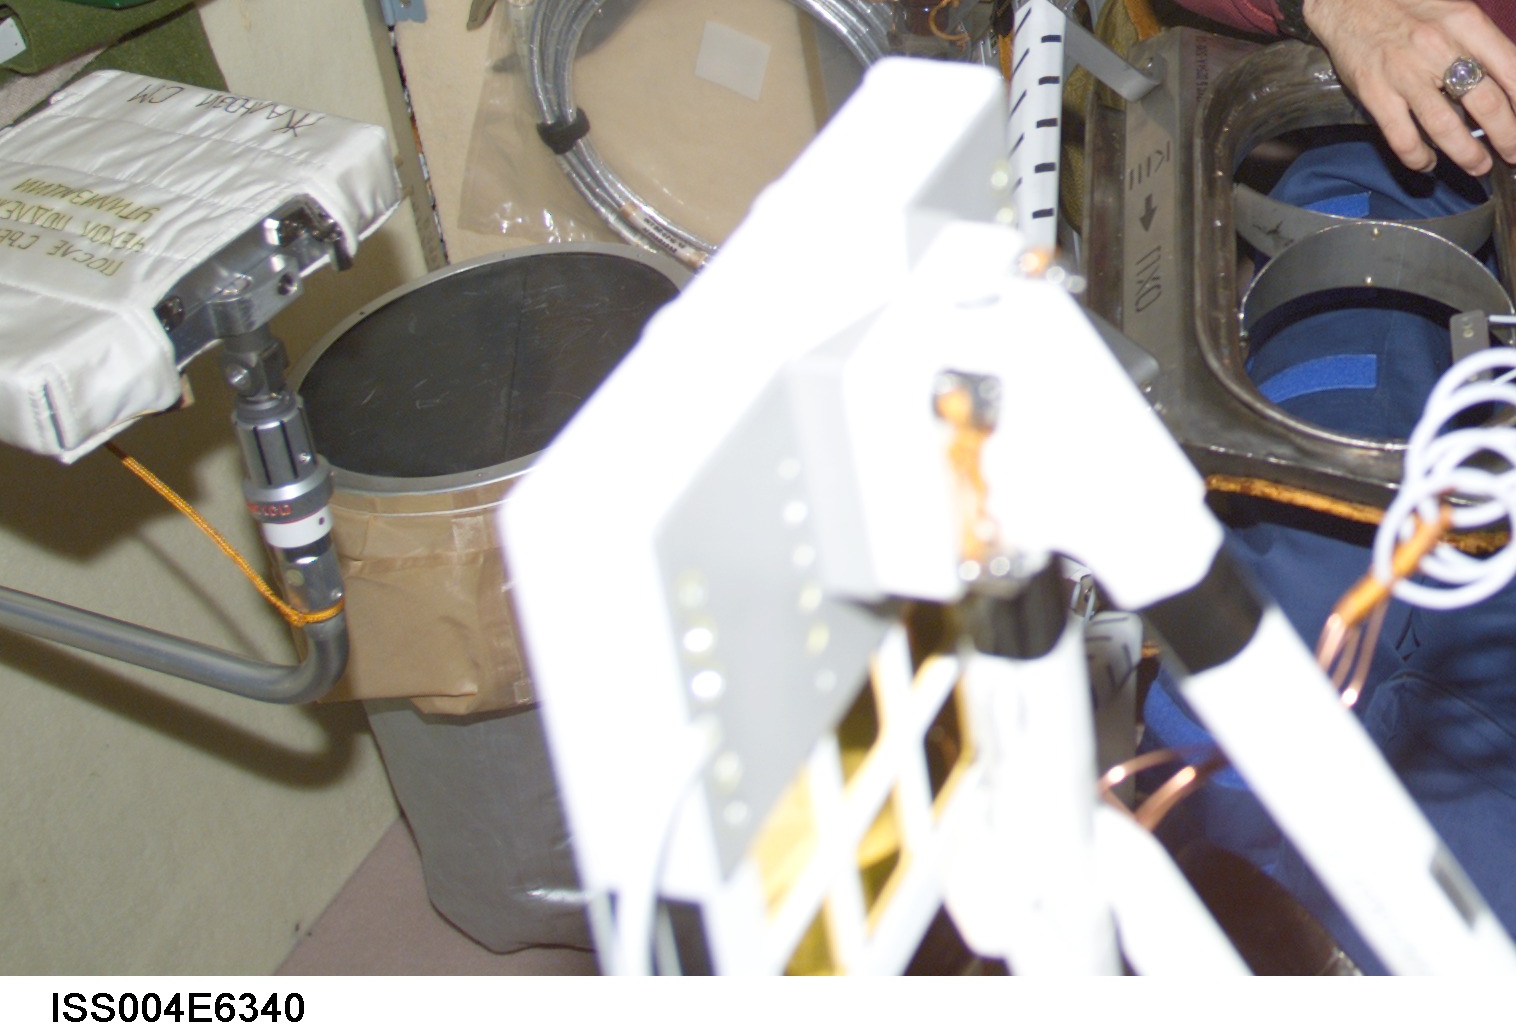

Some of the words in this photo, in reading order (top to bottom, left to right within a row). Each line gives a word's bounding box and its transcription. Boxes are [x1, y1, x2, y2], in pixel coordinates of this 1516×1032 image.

[127, 84, 185, 105] СМ
[195, 89, 327, 137] ЖАЛЮЗИ
[12, 177, 161, 223] УТИЛИЗАЦИИ
[80, 220, 147, 253] ЧЕХОЛ
[47, 239, 126, 277] ПОСЛЕ
